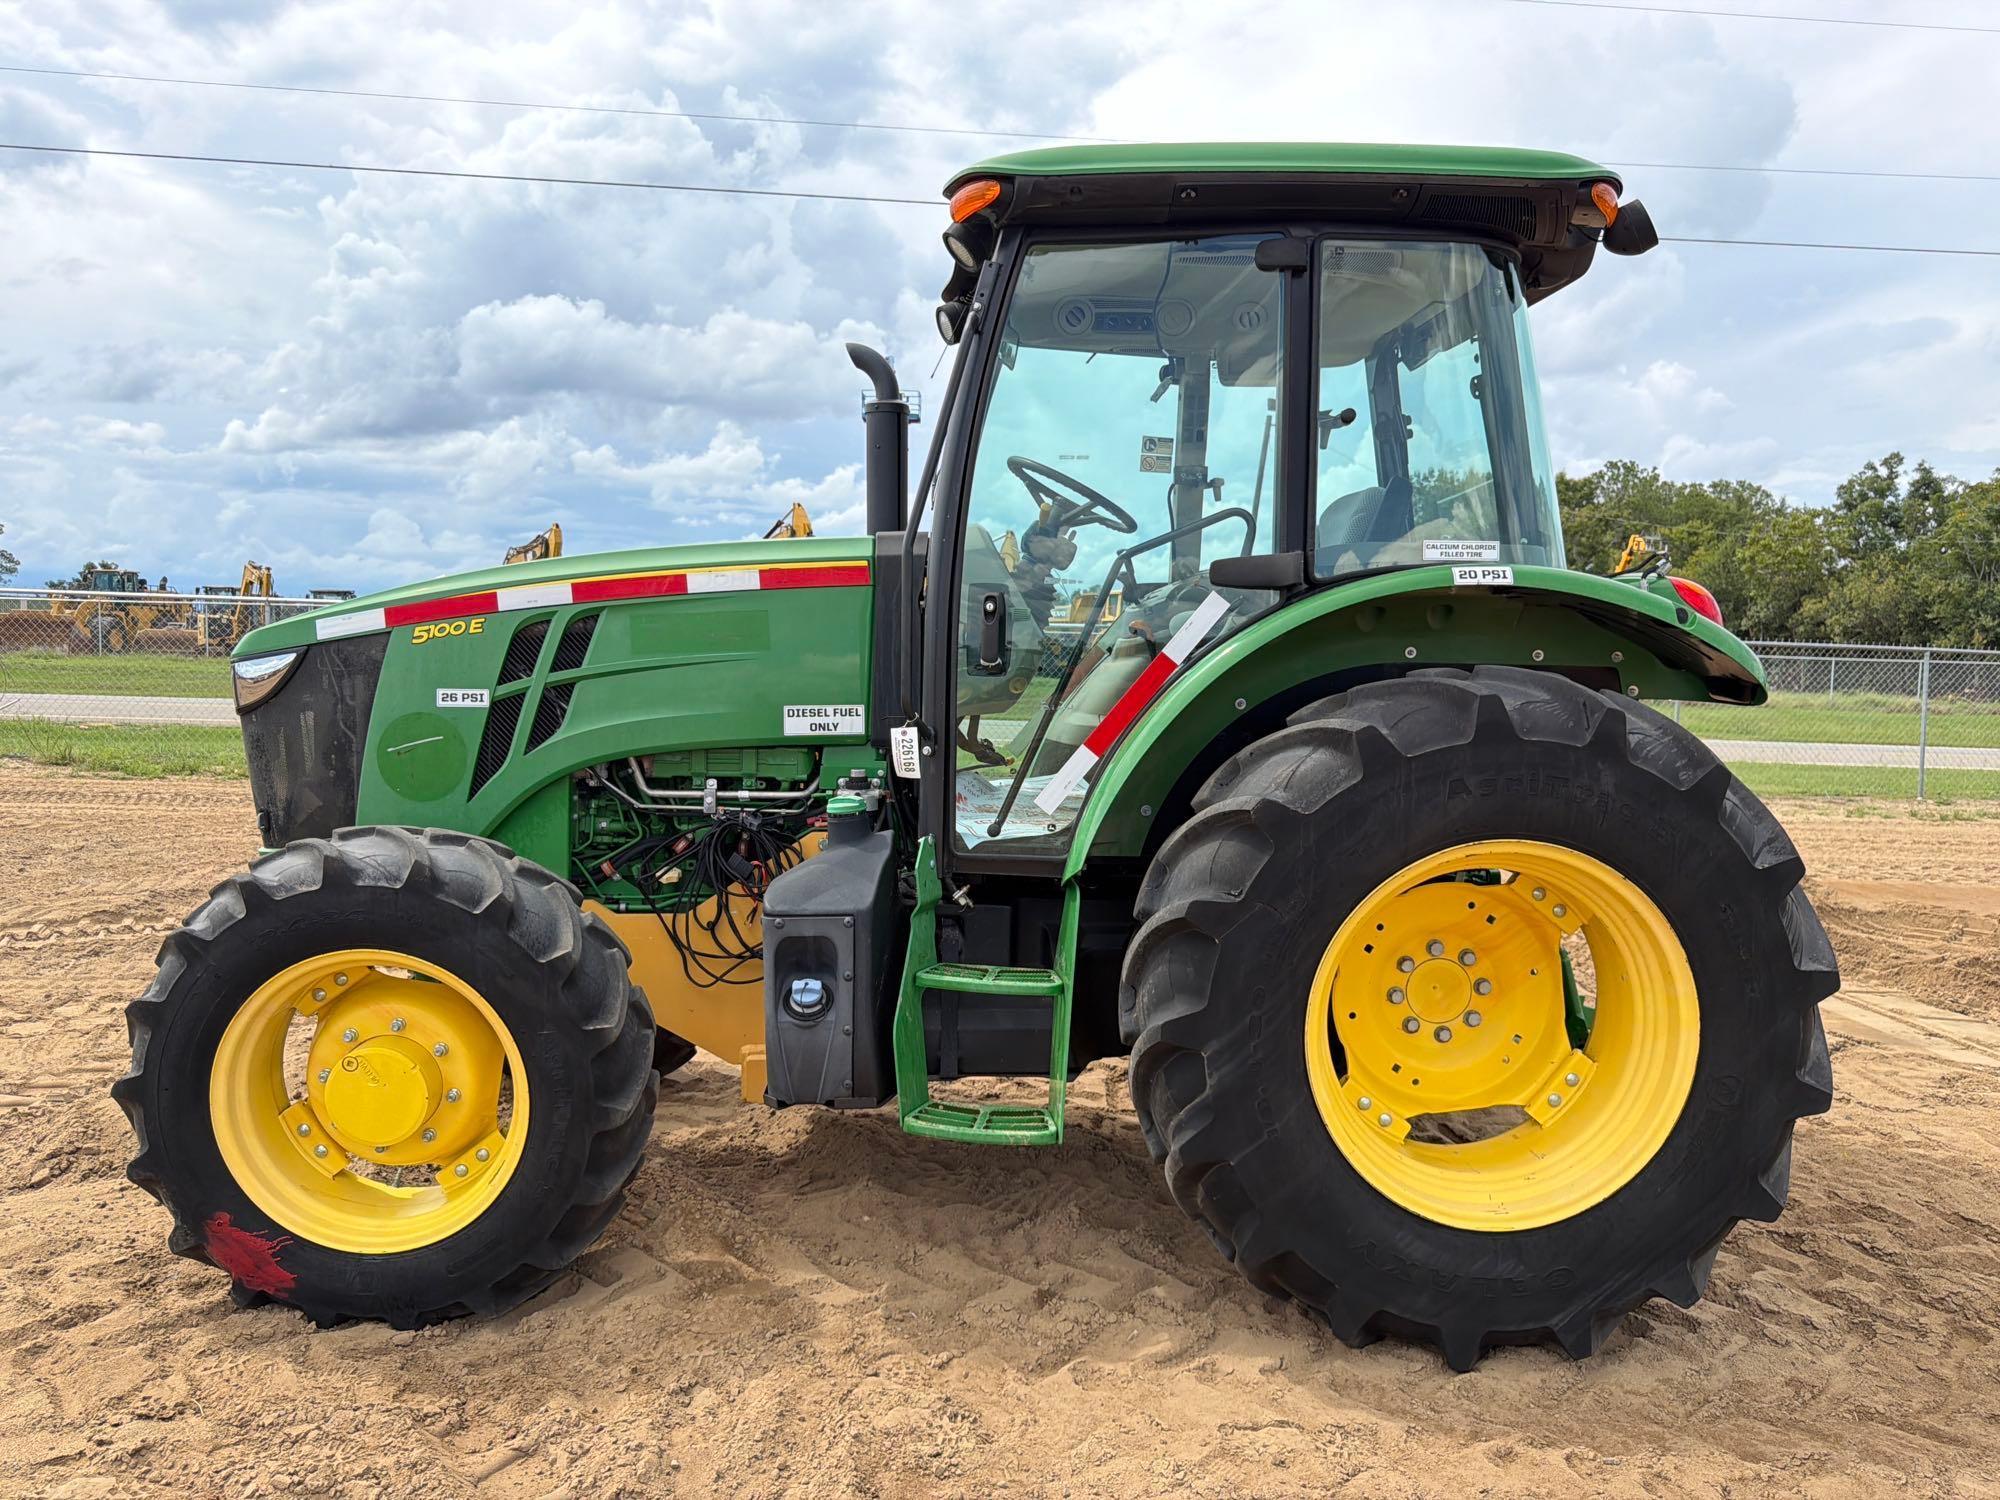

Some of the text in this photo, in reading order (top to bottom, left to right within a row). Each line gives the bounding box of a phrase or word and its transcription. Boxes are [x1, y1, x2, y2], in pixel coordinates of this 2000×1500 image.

[1458, 570, 1508, 579] 20 PSI
[411, 618, 487, 645] 5100 E
[441, 693, 485, 703] 26 PSI
[787, 708, 862, 718] DIESEL FUEL
[809, 722, 840, 732] ONLY
[901, 738, 916, 772] 226168
